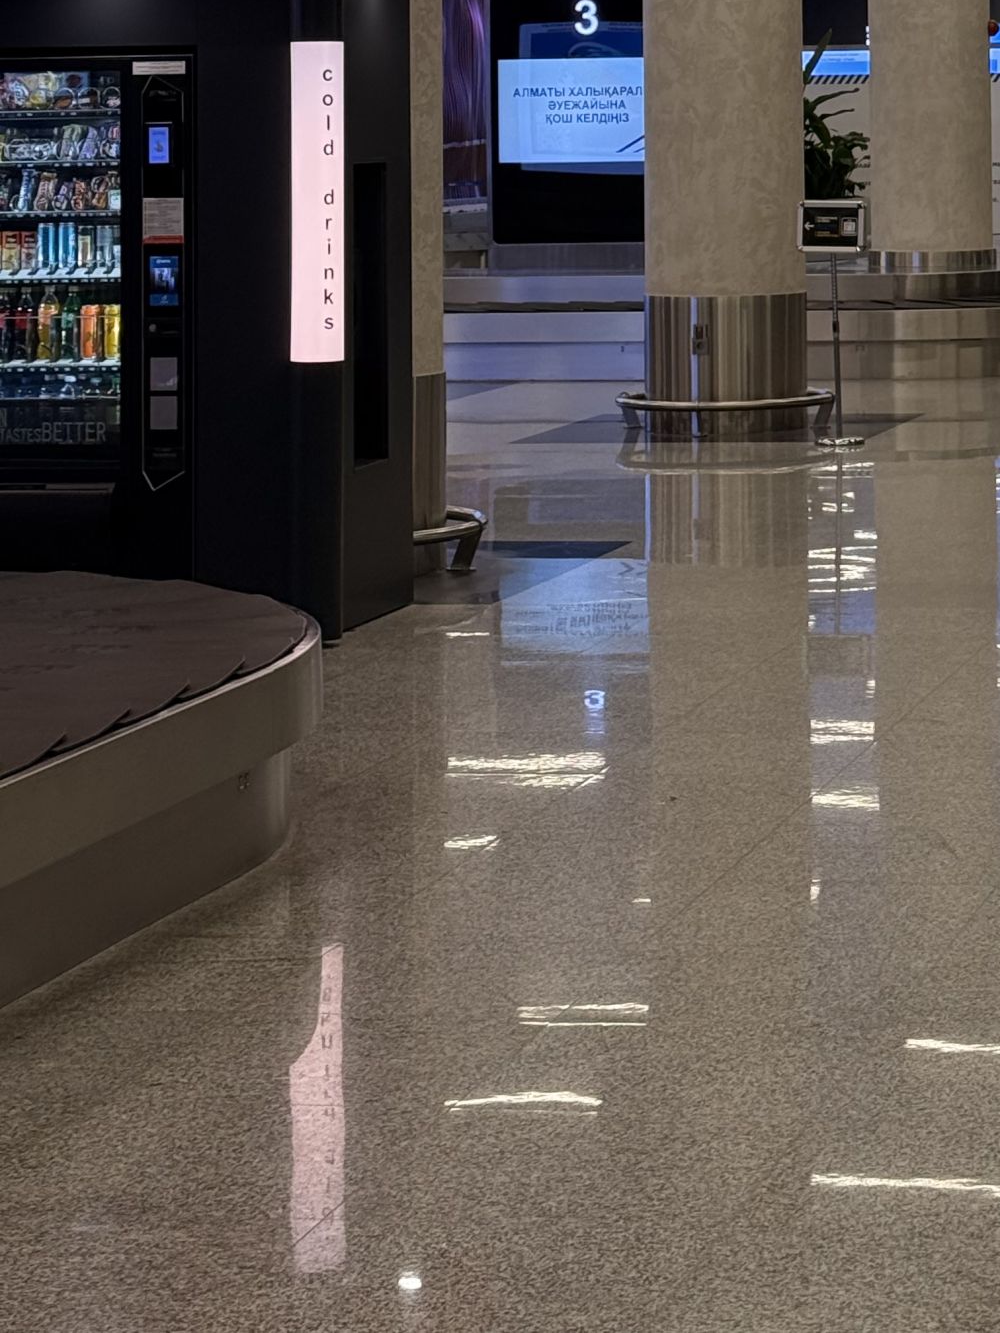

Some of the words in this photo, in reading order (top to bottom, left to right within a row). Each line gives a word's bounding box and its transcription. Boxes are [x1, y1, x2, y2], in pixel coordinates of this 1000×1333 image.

[513, 87, 565, 98] АЛМАТЫ
[548, 98, 627, 111] ӘУЕЖАЙЫНА
[322, 69, 334, 156] cold
[545, 113, 573, 125] ҚОШ
[323, 188, 335, 330] drinks
